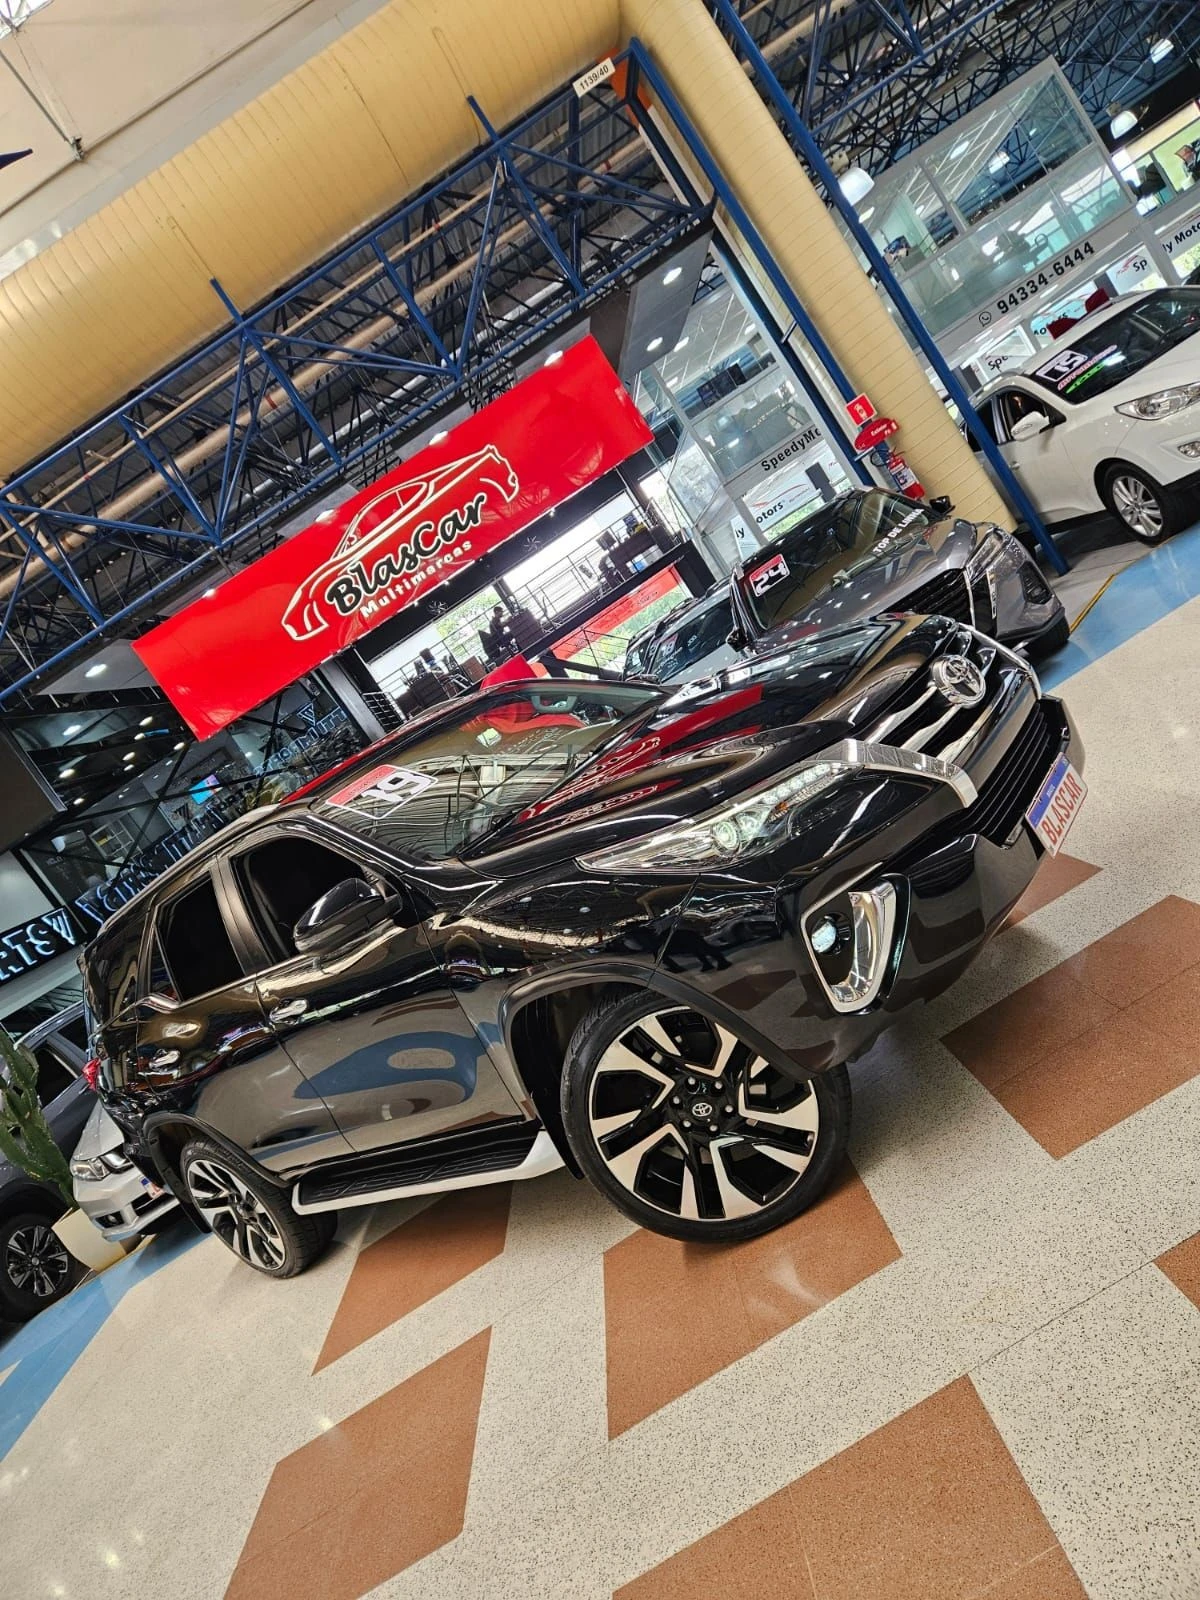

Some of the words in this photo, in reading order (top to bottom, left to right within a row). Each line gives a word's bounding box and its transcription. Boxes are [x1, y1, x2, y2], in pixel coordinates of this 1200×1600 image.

[580, 64, 609, 91] 1139/40
[996, 240, 1095, 314] 94334-6444
[326, 493, 486, 615] BlasCar
[873, 537, 889, 552] TOP
[887, 527, 903, 538] DE
[898, 508, 925, 528] LINHA
[360, 540, 472, 618] Multimarcas
[756, 563, 787, 593] 24
[361, 771, 432, 803] 19
[1041, 772, 1083, 846] BLASCAR
